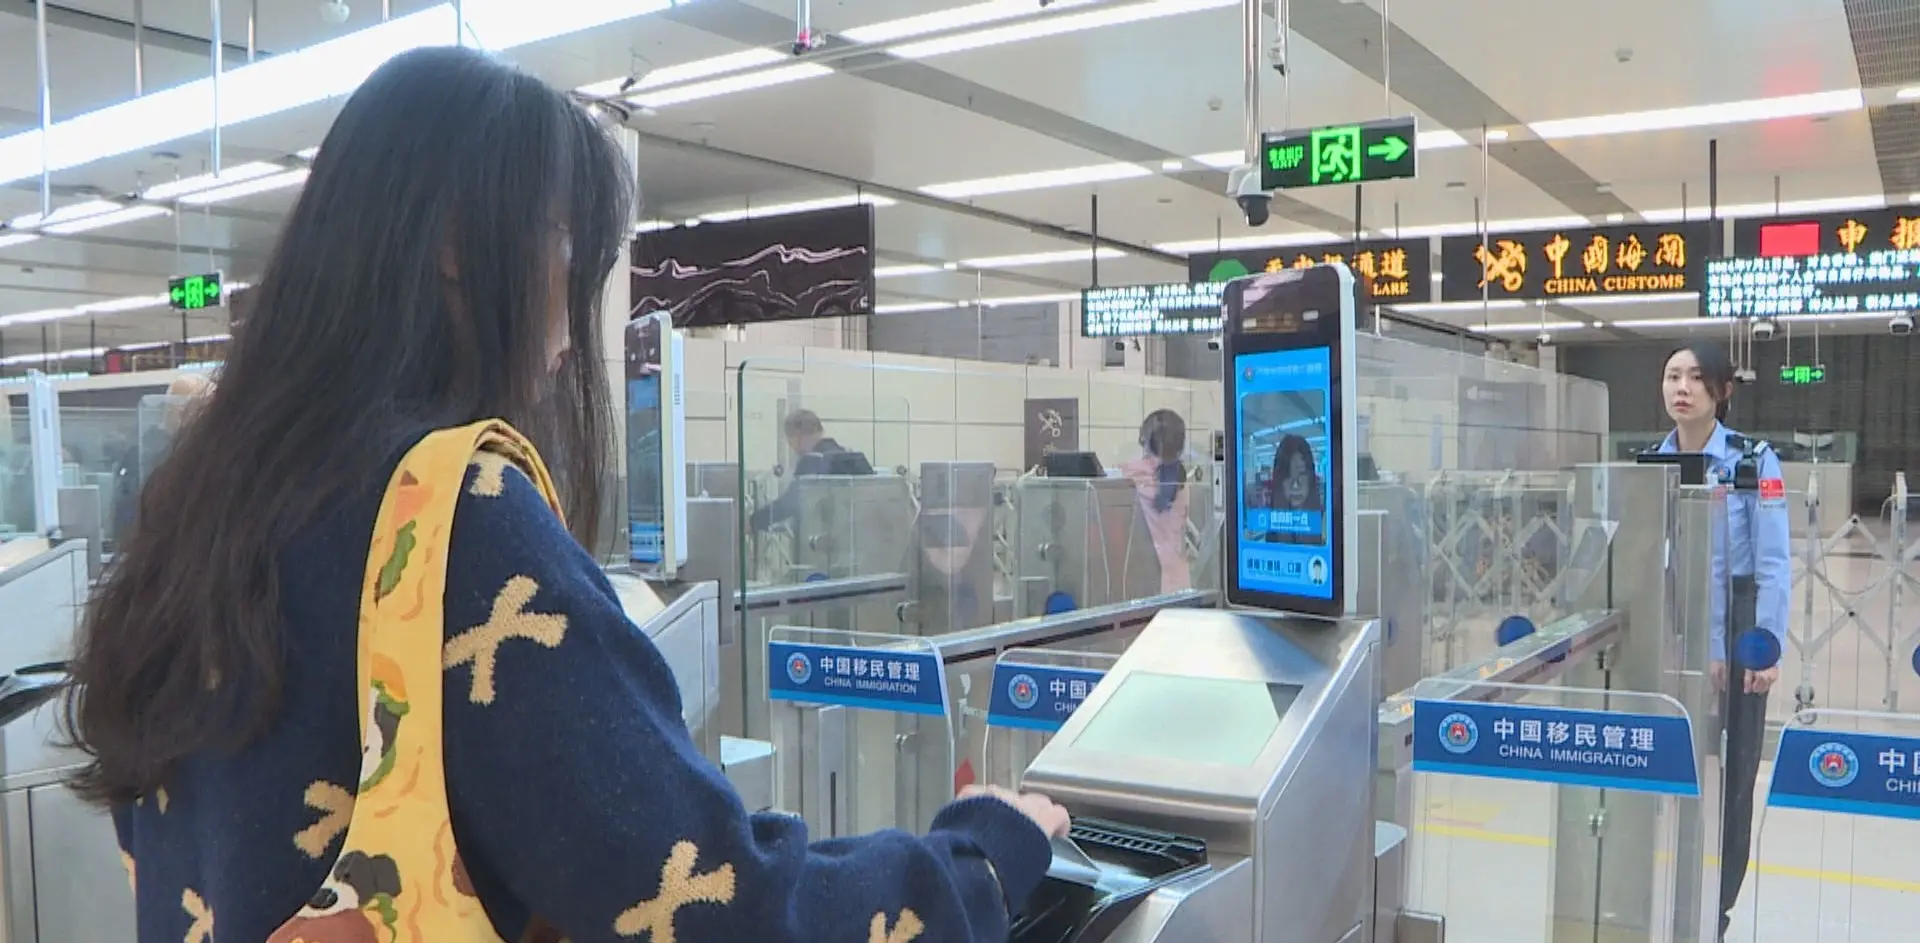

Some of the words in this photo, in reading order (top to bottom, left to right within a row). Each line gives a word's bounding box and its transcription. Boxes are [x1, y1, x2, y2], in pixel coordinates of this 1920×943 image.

[1545, 279, 1597, 294] CHINA
[1603, 274, 1685, 291] CUSTOMS
[820, 655, 919, 681] 中国移民管理
[824, 676, 852, 688] CHINA
[856, 679, 917, 694] IMMIGRATION
[1494, 717, 1654, 751] 中国移民管理
[1499, 744, 1543, 760] CHINA
[1550, 750, 1648, 768] IMMIGRATION
[1879, 748, 1920, 775] 中
